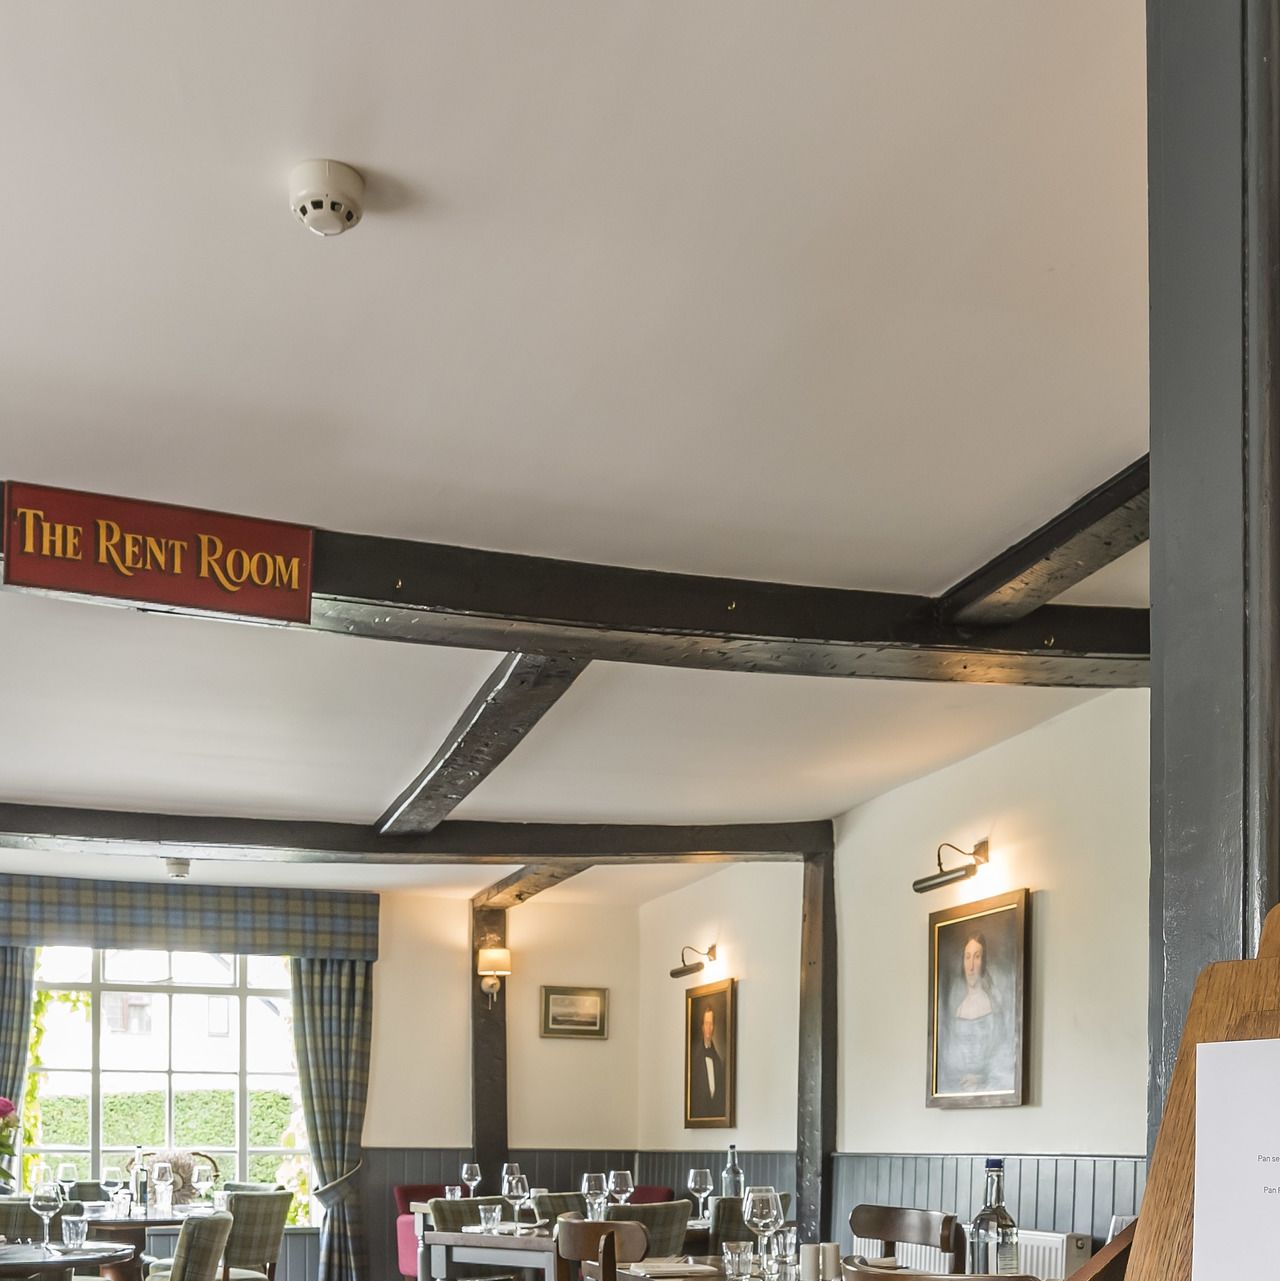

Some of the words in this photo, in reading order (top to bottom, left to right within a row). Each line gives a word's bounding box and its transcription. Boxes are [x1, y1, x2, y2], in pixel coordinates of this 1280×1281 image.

[17, 507, 82, 560] THE
[96, 518, 188, 576] RENT
[198, 533, 300, 592] ROOM
[1258, 1154, 1270, 1162] Pan
[1264, 1186, 1276, 1194] Pan
